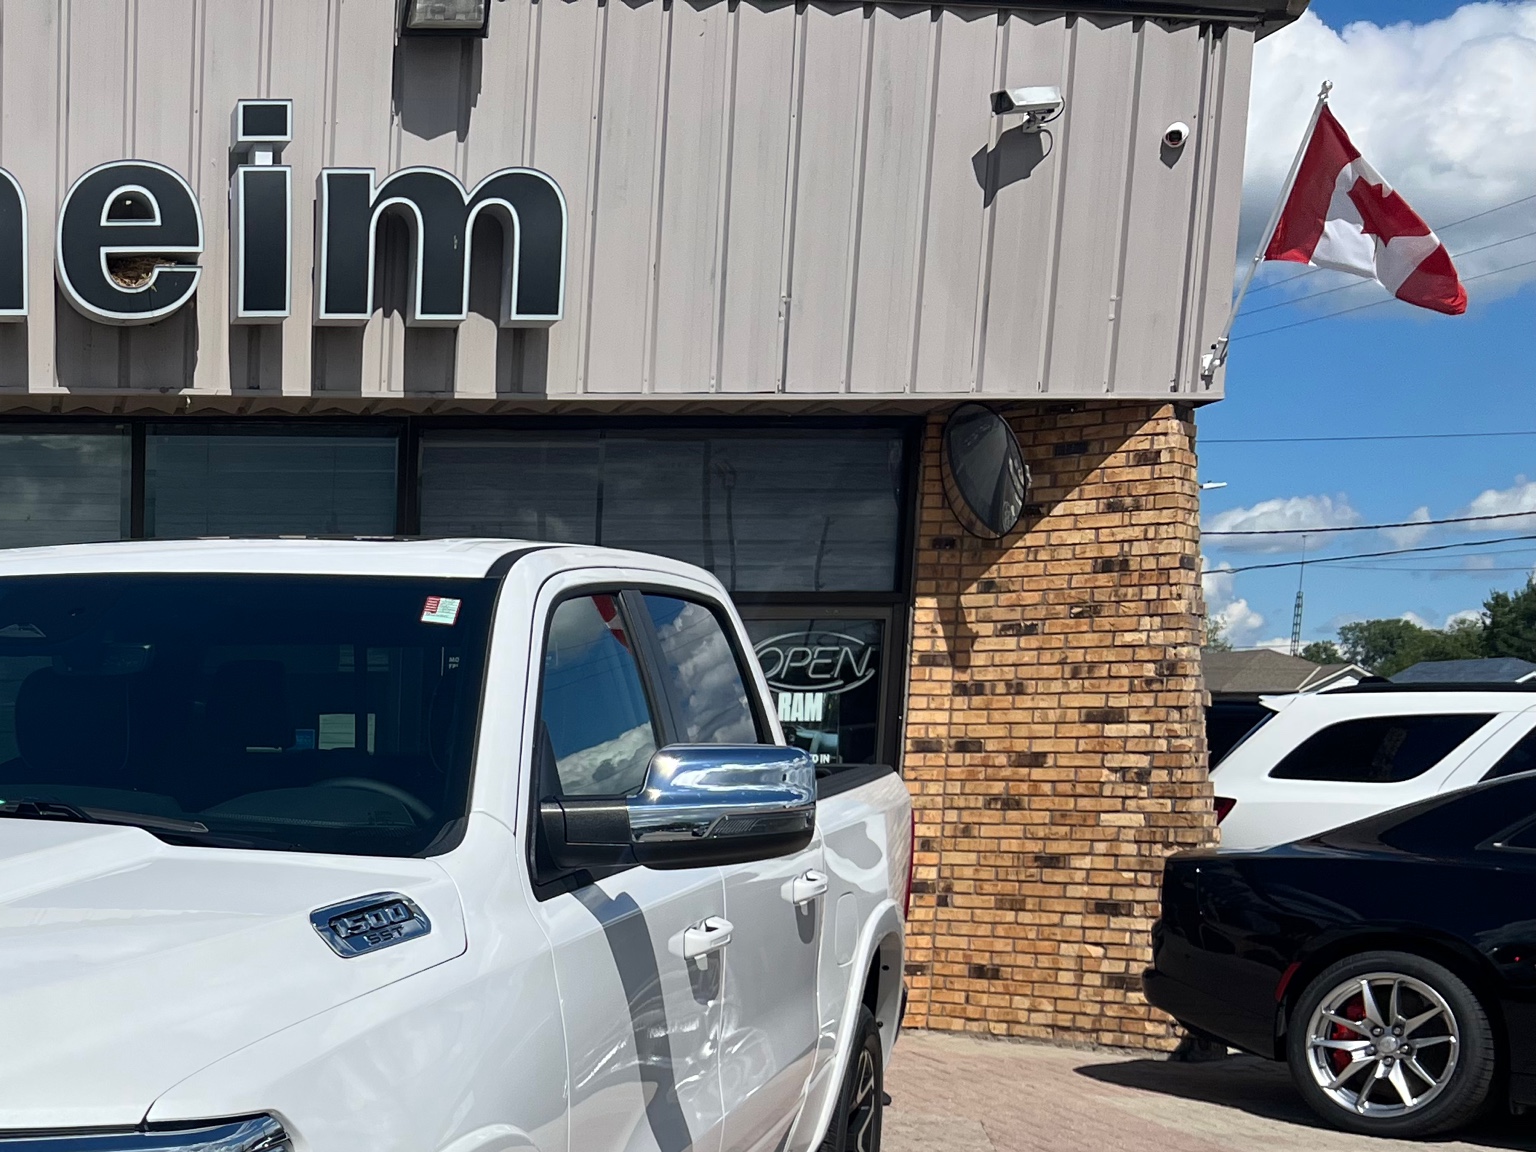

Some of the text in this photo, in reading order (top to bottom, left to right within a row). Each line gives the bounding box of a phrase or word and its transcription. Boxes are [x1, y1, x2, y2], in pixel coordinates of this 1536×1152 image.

[757, 646, 872, 679] OPEN
[778, 692, 823, 722] RAM
[330, 901, 409, 938] 1500
[364, 924, 404, 946] SST
